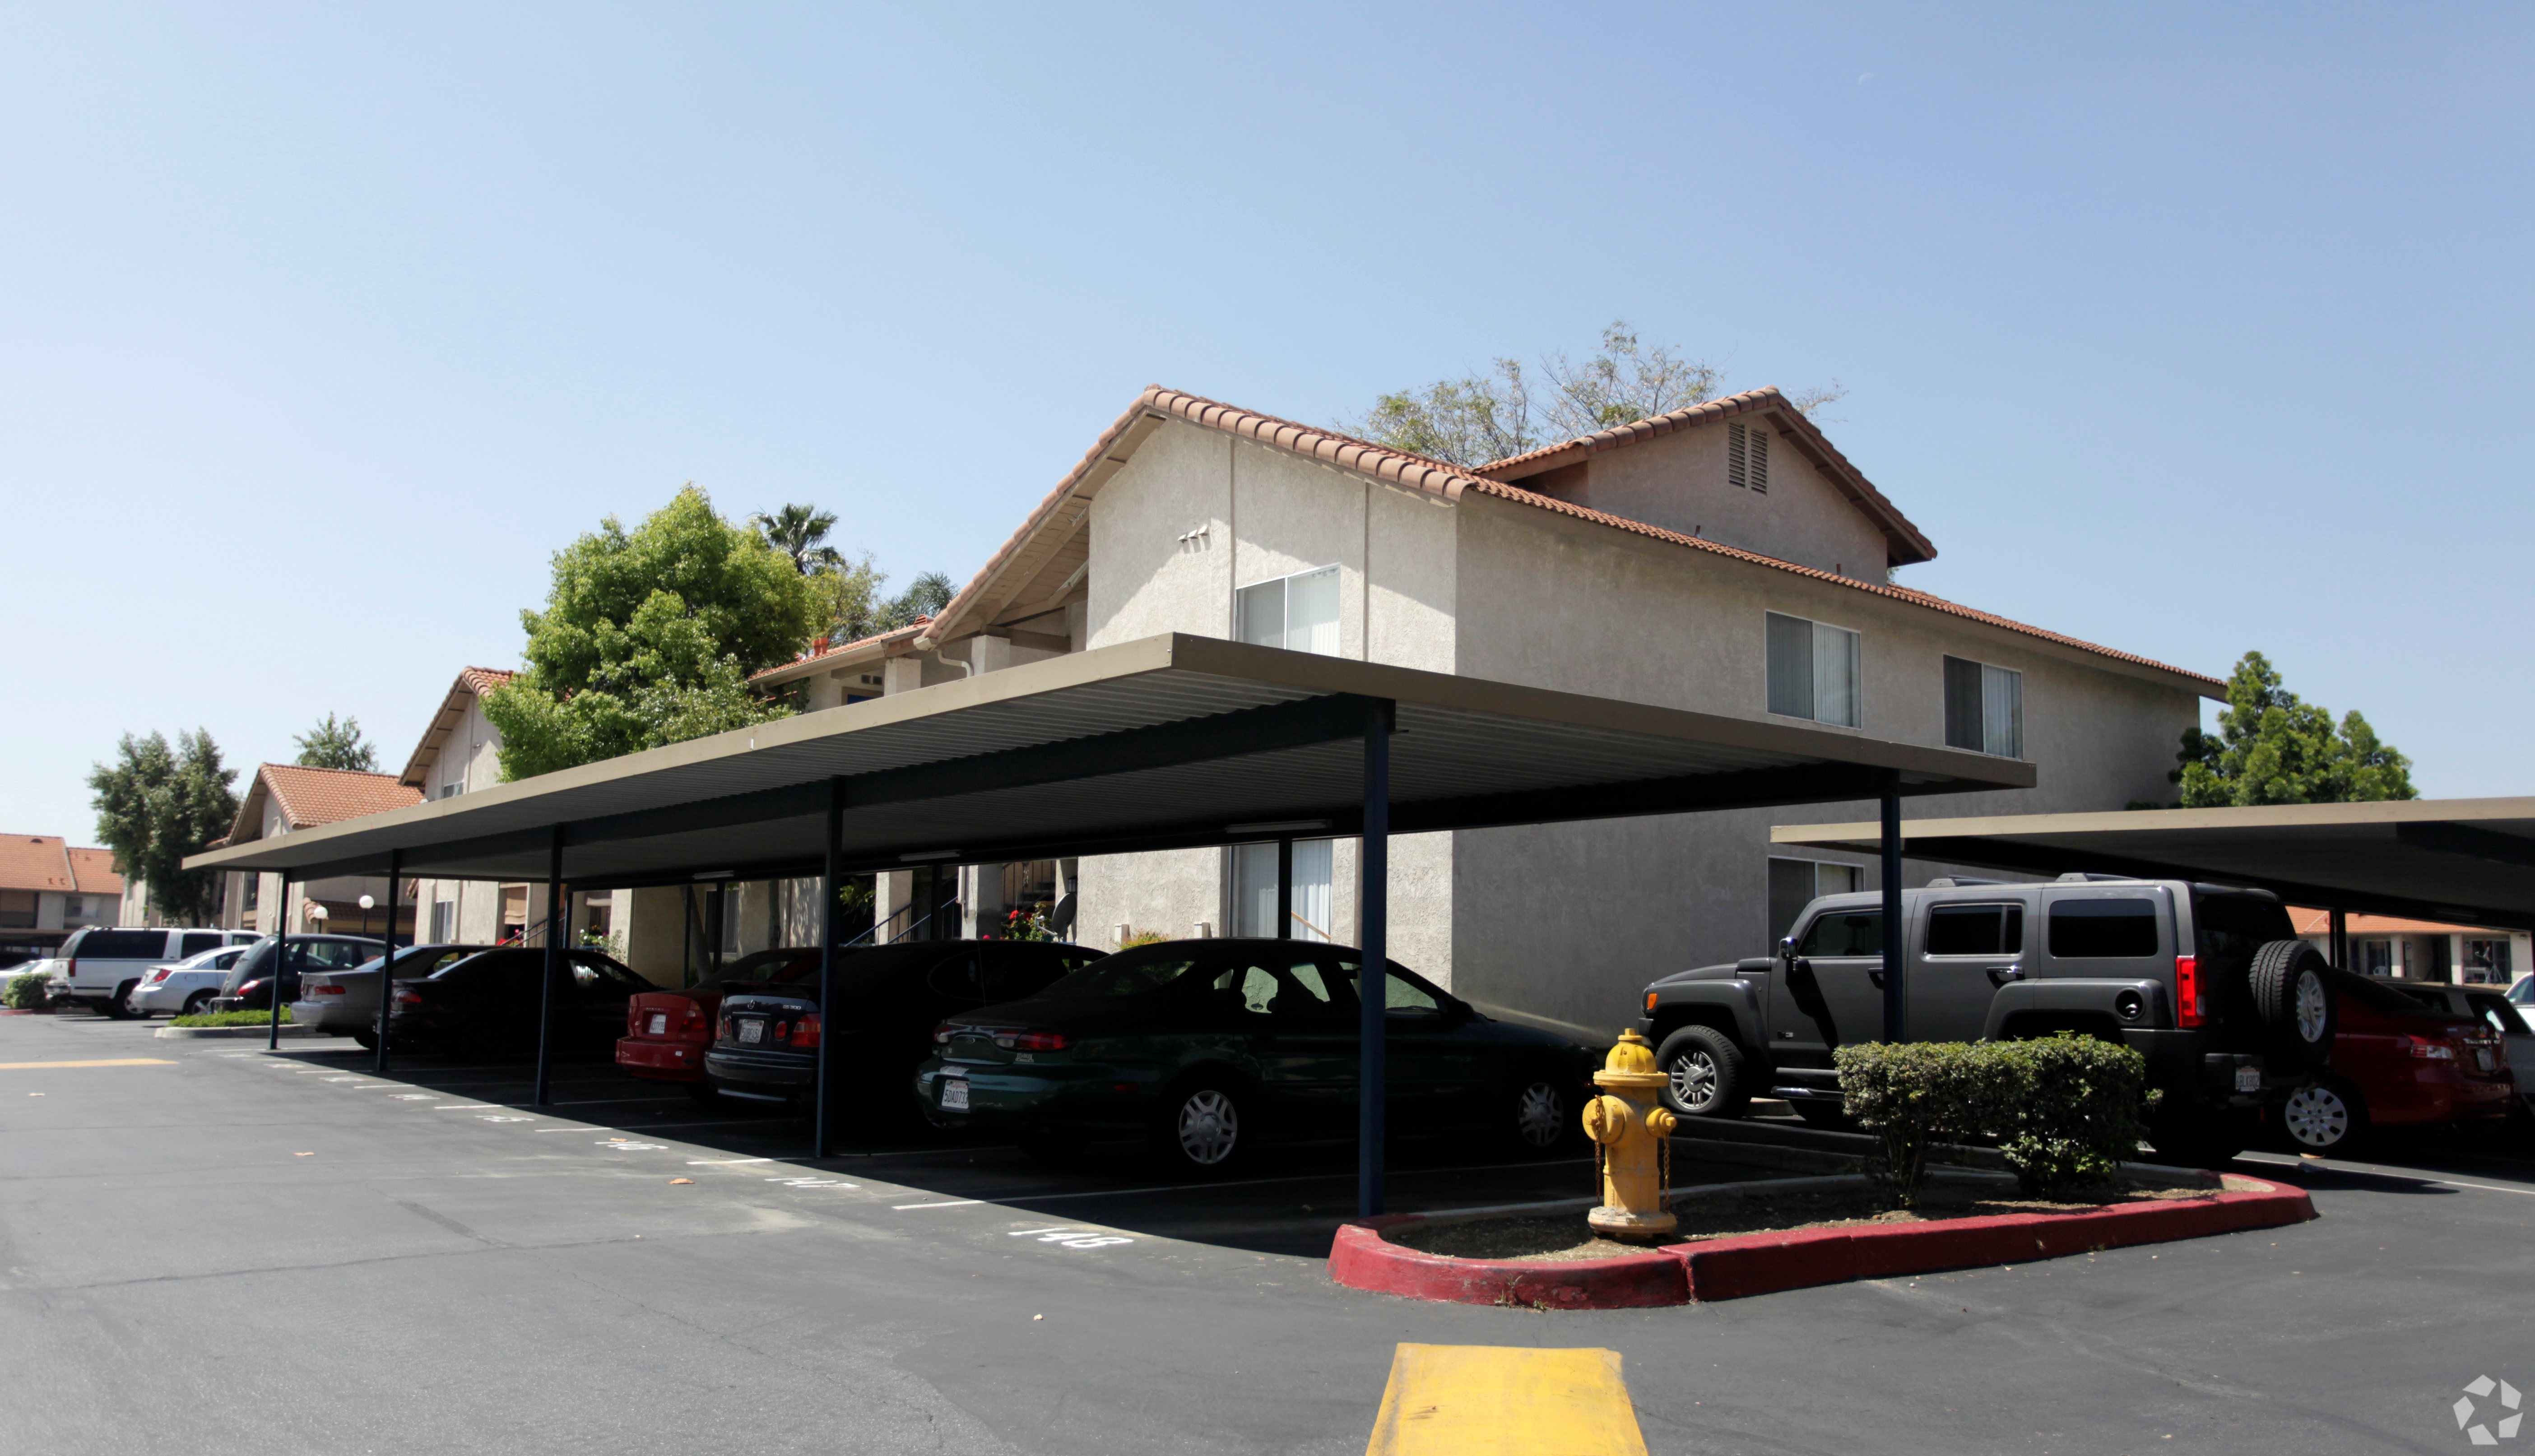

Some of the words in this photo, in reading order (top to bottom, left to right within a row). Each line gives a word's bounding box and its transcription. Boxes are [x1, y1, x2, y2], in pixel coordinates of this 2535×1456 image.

[944, 1090, 968, 1104] 5DAD733
[764, 1177, 862, 1187] 147
[1008, 1227, 1134, 1248] 148
